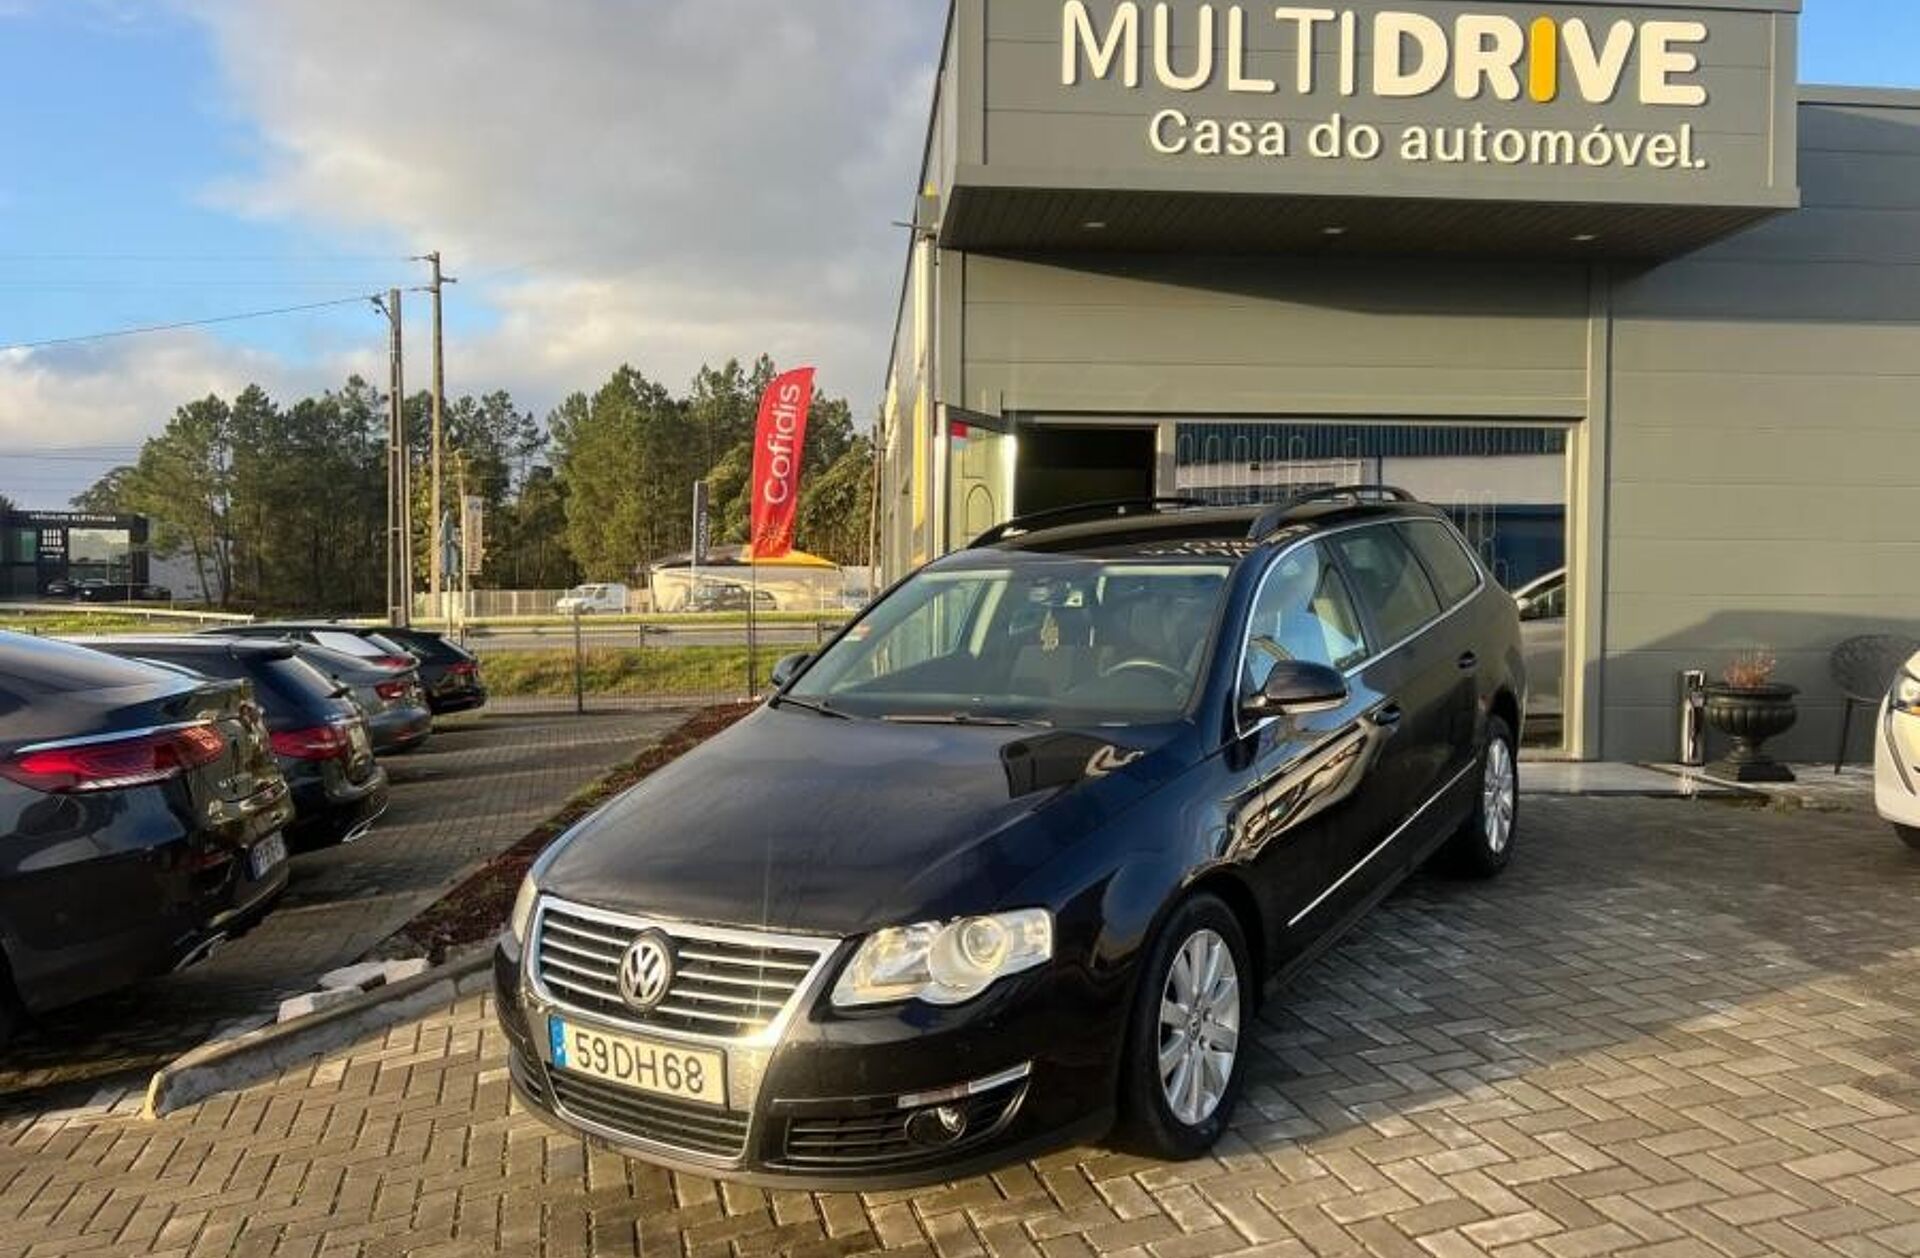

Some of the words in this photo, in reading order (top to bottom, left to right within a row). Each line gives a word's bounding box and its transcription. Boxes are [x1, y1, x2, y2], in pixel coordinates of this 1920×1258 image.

[1150, 108, 1286, 157] Casa
[1308, 112, 1381, 159] do
[1400, 121, 1707, 169] automóvel.
[764, 384, 801, 504] Cofidis
[575, 1032, 704, 1094] 59DH68
